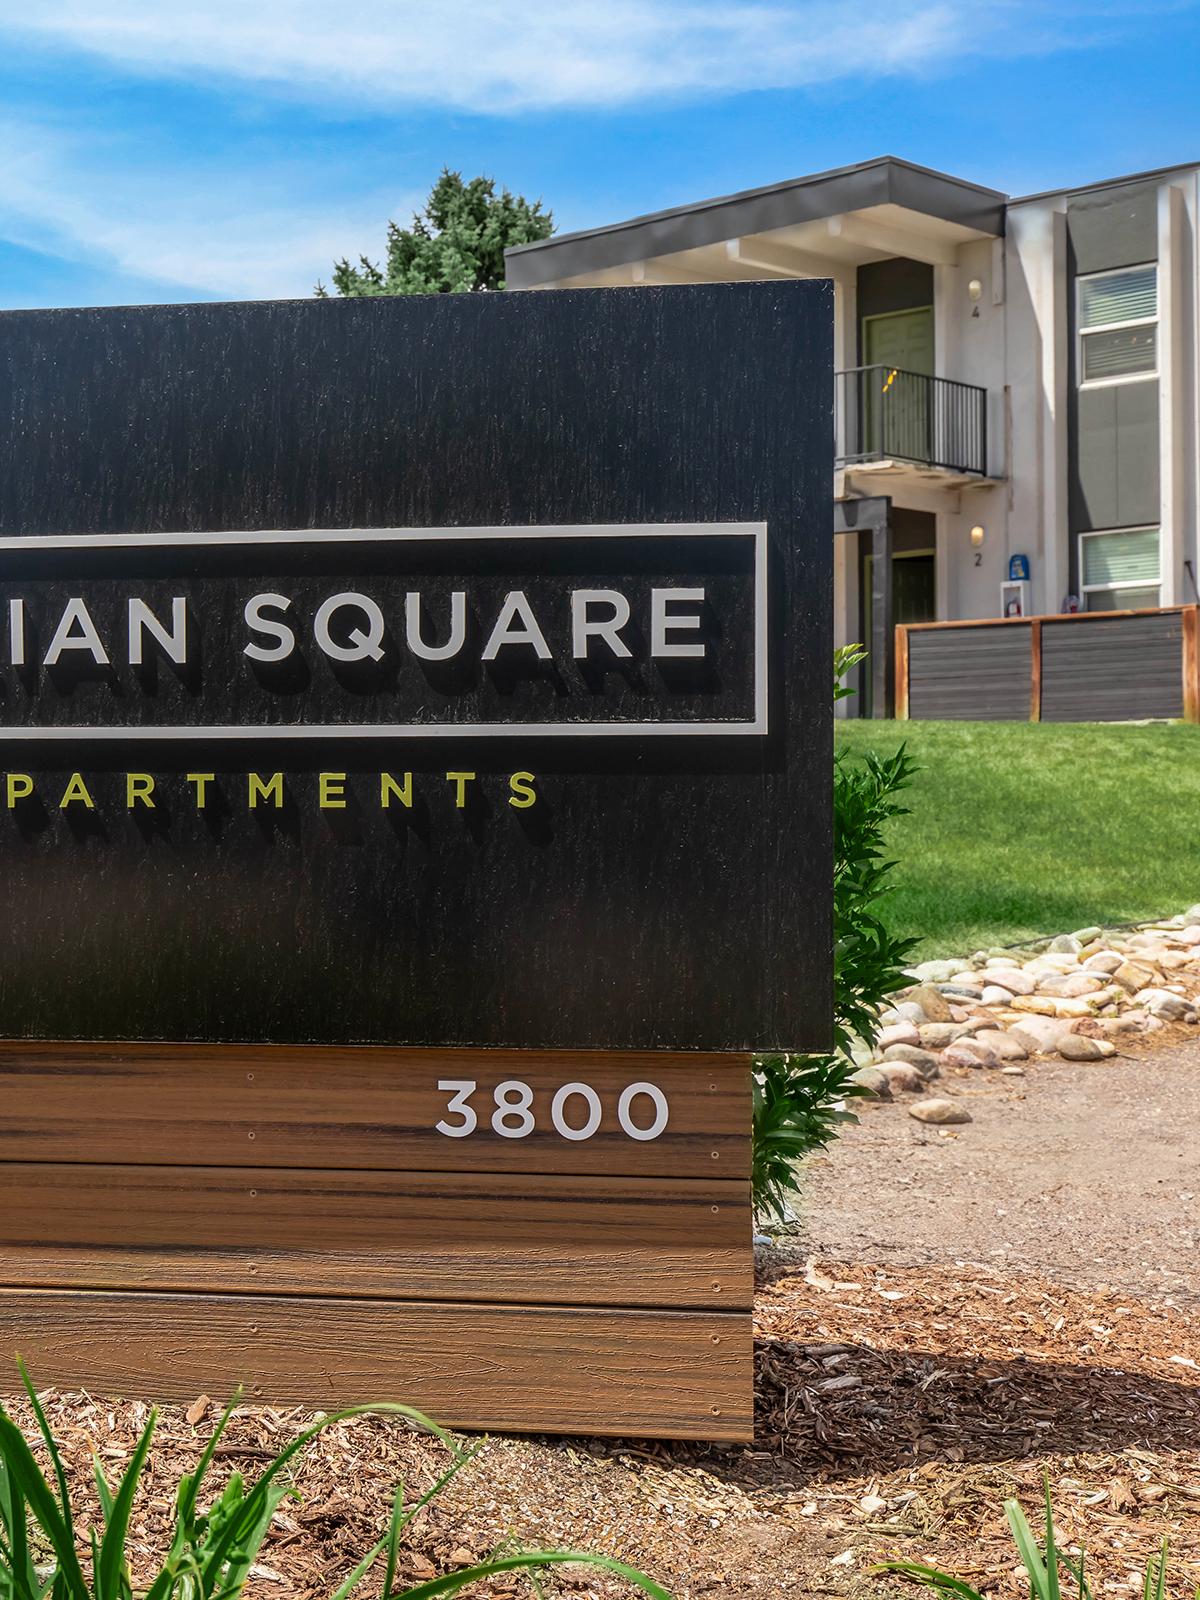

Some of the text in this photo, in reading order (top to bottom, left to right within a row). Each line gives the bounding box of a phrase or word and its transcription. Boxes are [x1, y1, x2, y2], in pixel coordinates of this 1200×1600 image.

[971, 305, 980, 319] 4
[974, 552, 983, 567] 2
[242, 586, 706, 664] SQUARE
[434, 1080, 669, 1141] 3800
